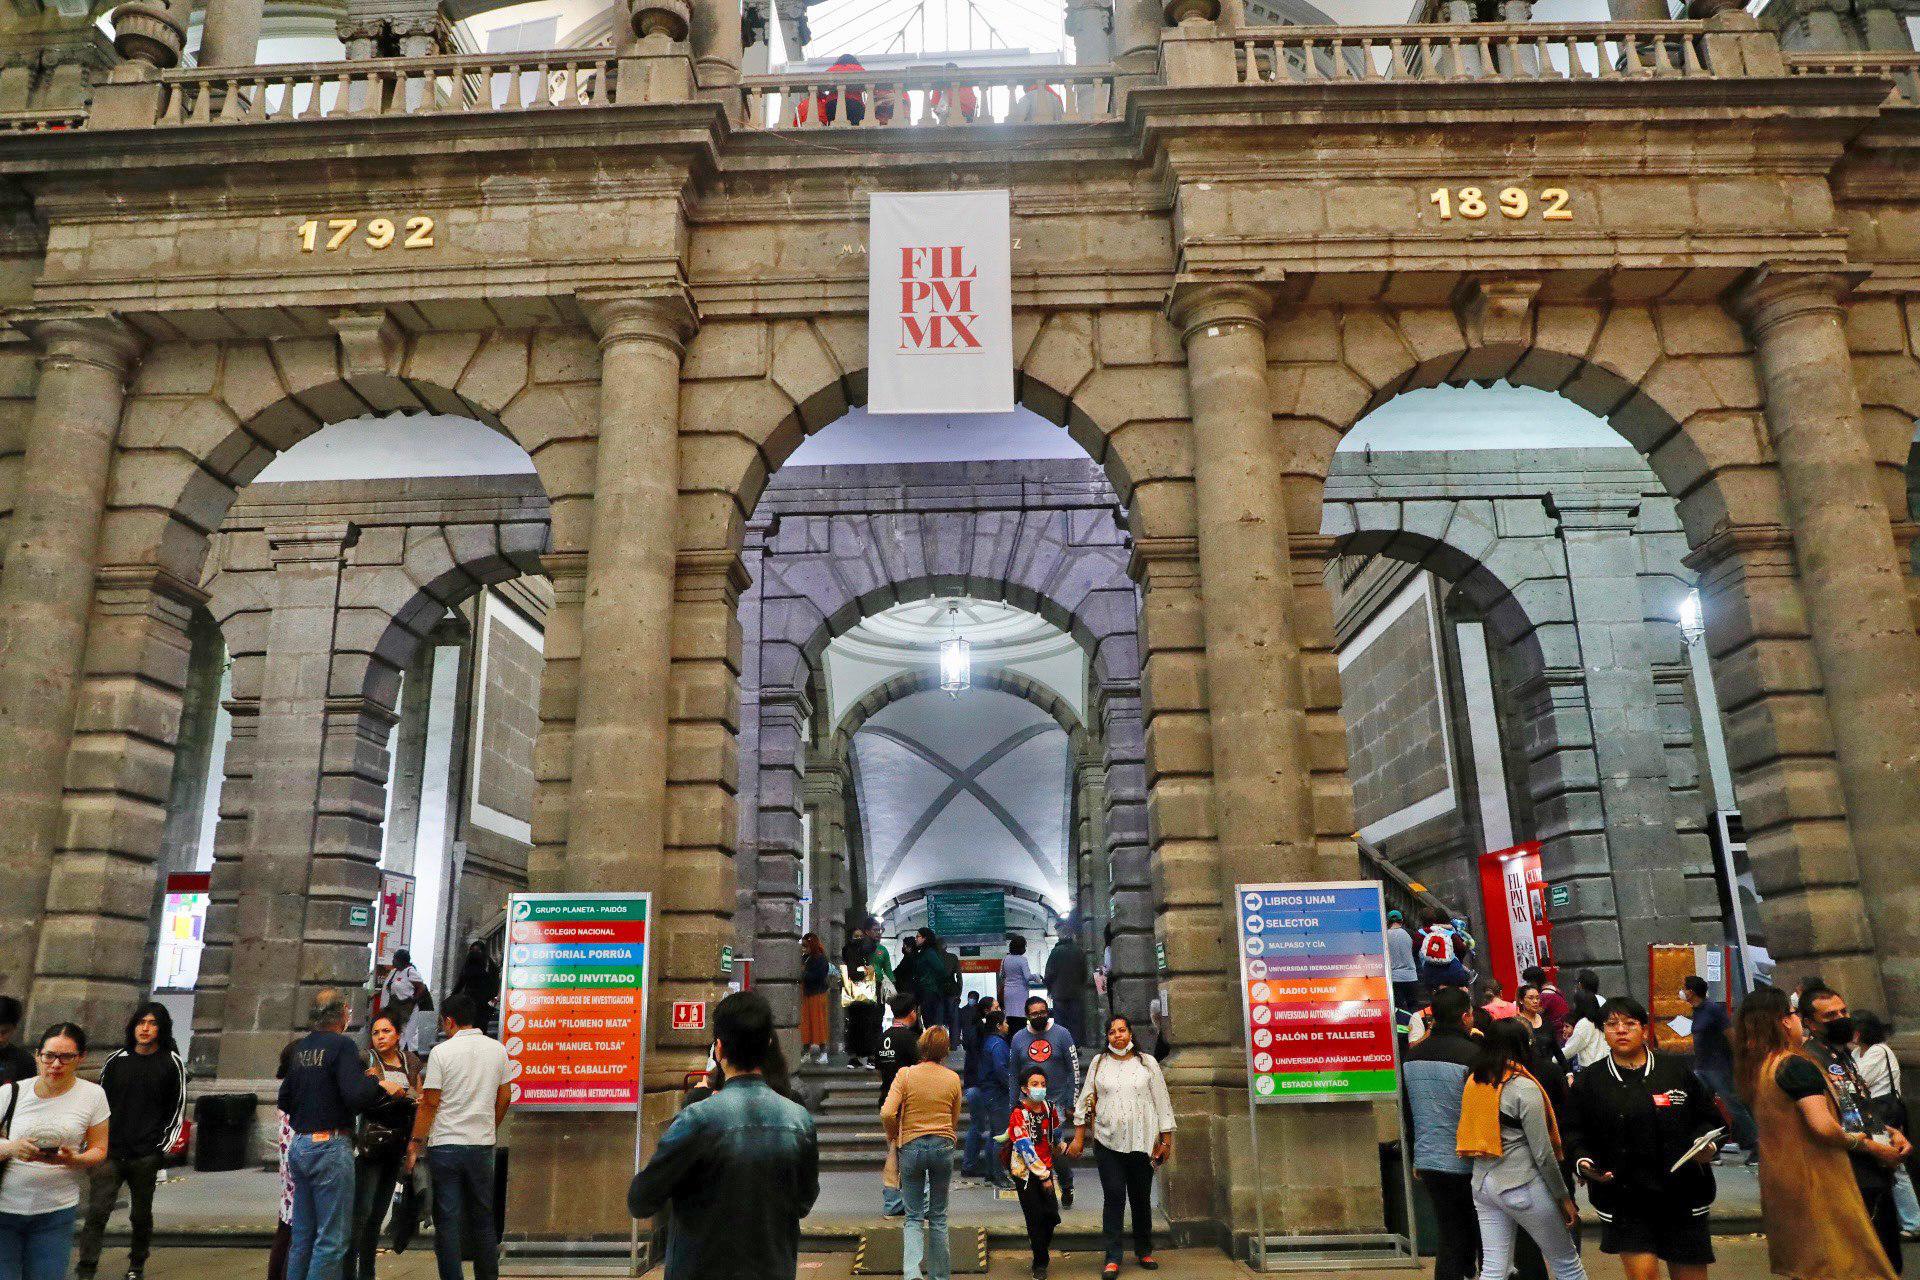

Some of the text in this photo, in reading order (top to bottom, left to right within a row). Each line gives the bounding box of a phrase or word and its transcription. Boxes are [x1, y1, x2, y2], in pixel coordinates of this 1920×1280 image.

[1430, 187, 1573, 220] 1892
[298, 216, 435, 252] 1792
[899, 245, 978, 279] FIL
[899, 280, 974, 313] PM
[899, 314, 983, 349] MX
[1264, 895, 1336, 906] LIBROS UNAM
[1510, 889, 1524, 907] PM
[1512, 906, 1527, 923] MX
[1265, 918, 1319, 928] SELECTOR
[532, 948, 632, 959] EDITORIAL PORRÚA
[1268, 965, 1308, 973] UNIVERSIDAD
[579, 974, 635, 983] INVITADO
[1279, 986, 1337, 995] RADIO UNAM
[555, 994, 583, 1005] PÚBLICOS
[583, 995, 591, 1004] DE
[1274, 1010, 1309, 1020] UNIVERSIDAD
[527, 1017, 556, 1028] SALÓN
[1275, 1030, 1376, 1041] SALÓN DE TALLERES
[526, 1040, 554, 1051] SALÓN
[1275, 1053, 1392, 1065] UNIVERSIDAD ANÁHUAC MÉXICO
[525, 1063, 627, 1075] SALÓN "EL CABALLITO"
[1281, 1080, 1349, 1089] ESTADO INVITADO
[524, 1089, 558, 1099] UNIVERSIDAD
[587, 1088, 631, 1098] METROPOLITANA
